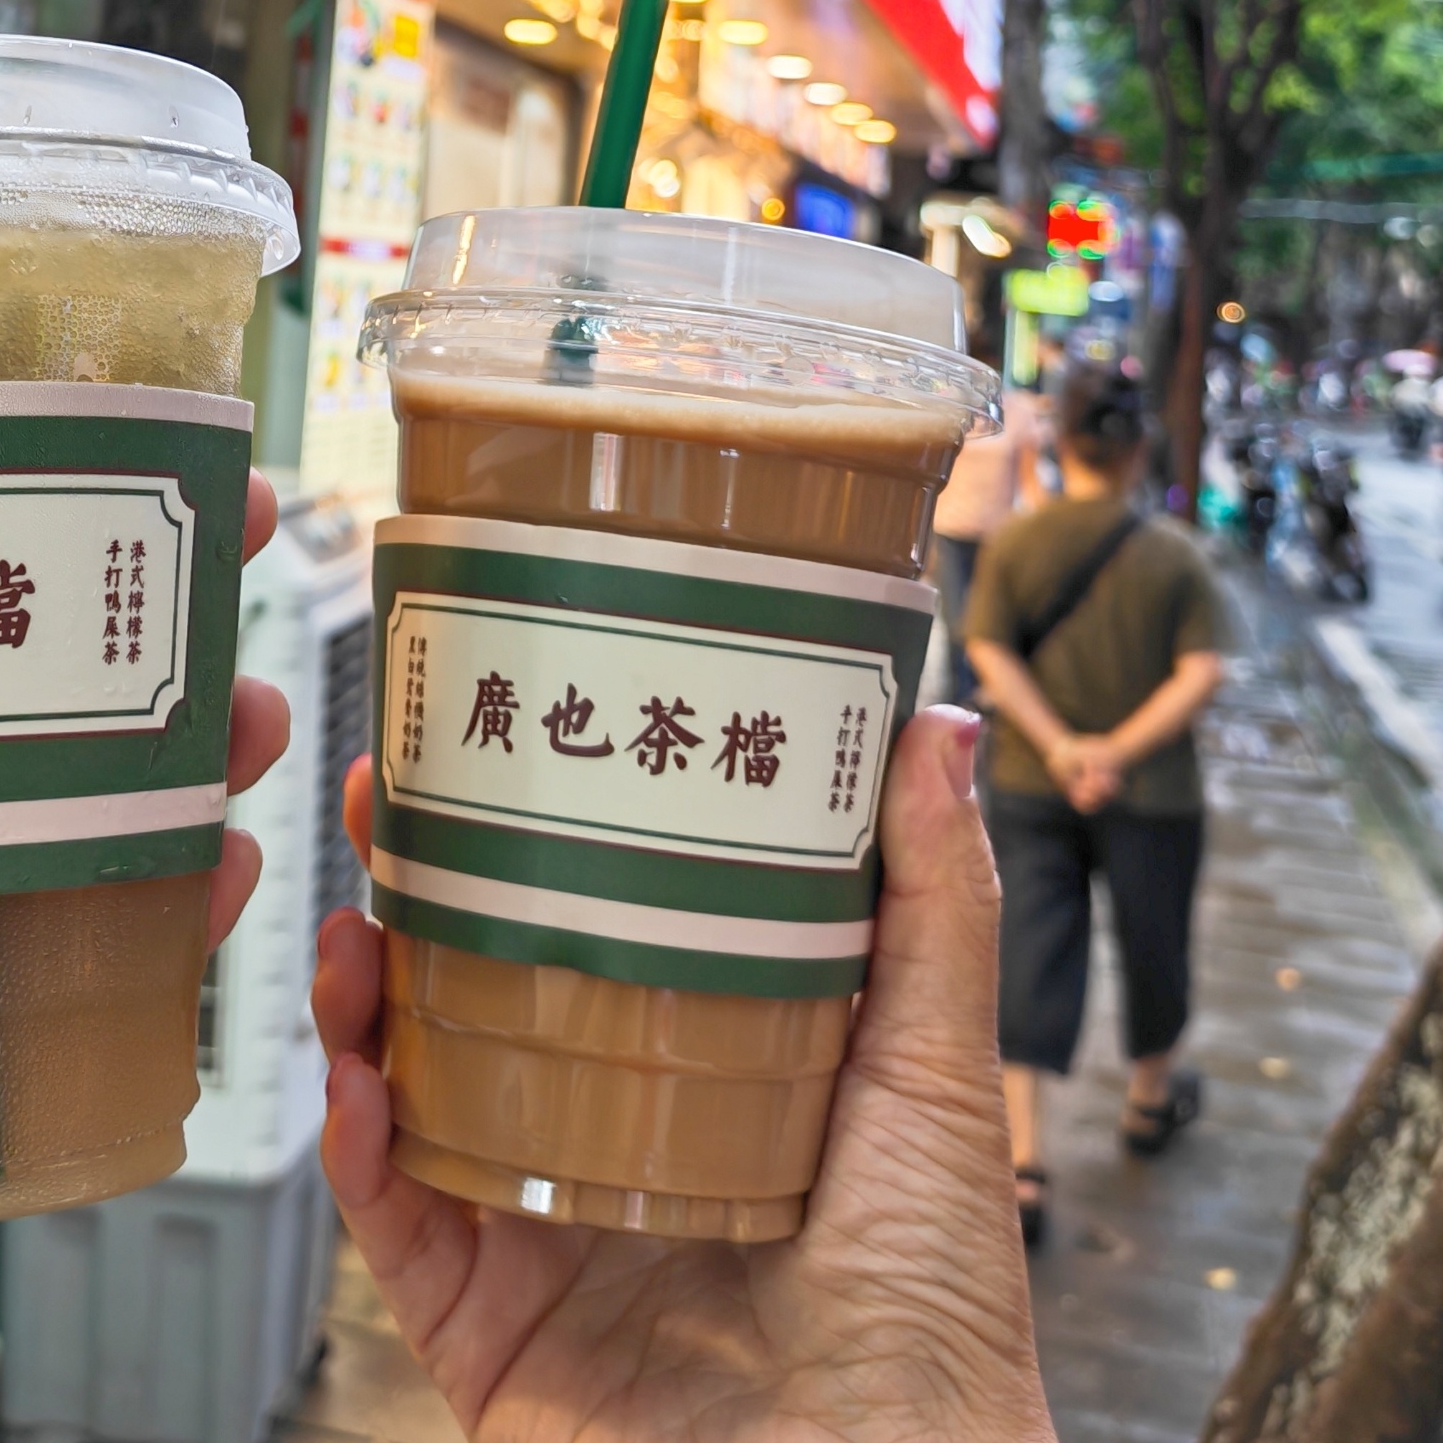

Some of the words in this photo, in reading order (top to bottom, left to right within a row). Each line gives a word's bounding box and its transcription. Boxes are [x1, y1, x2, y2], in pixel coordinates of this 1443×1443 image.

[102, 539, 123, 665] 手打鴨屎茶
[126, 539, 147, 665] 港式檸檬茶
[462, 670, 787, 788] 廣也茶檔
